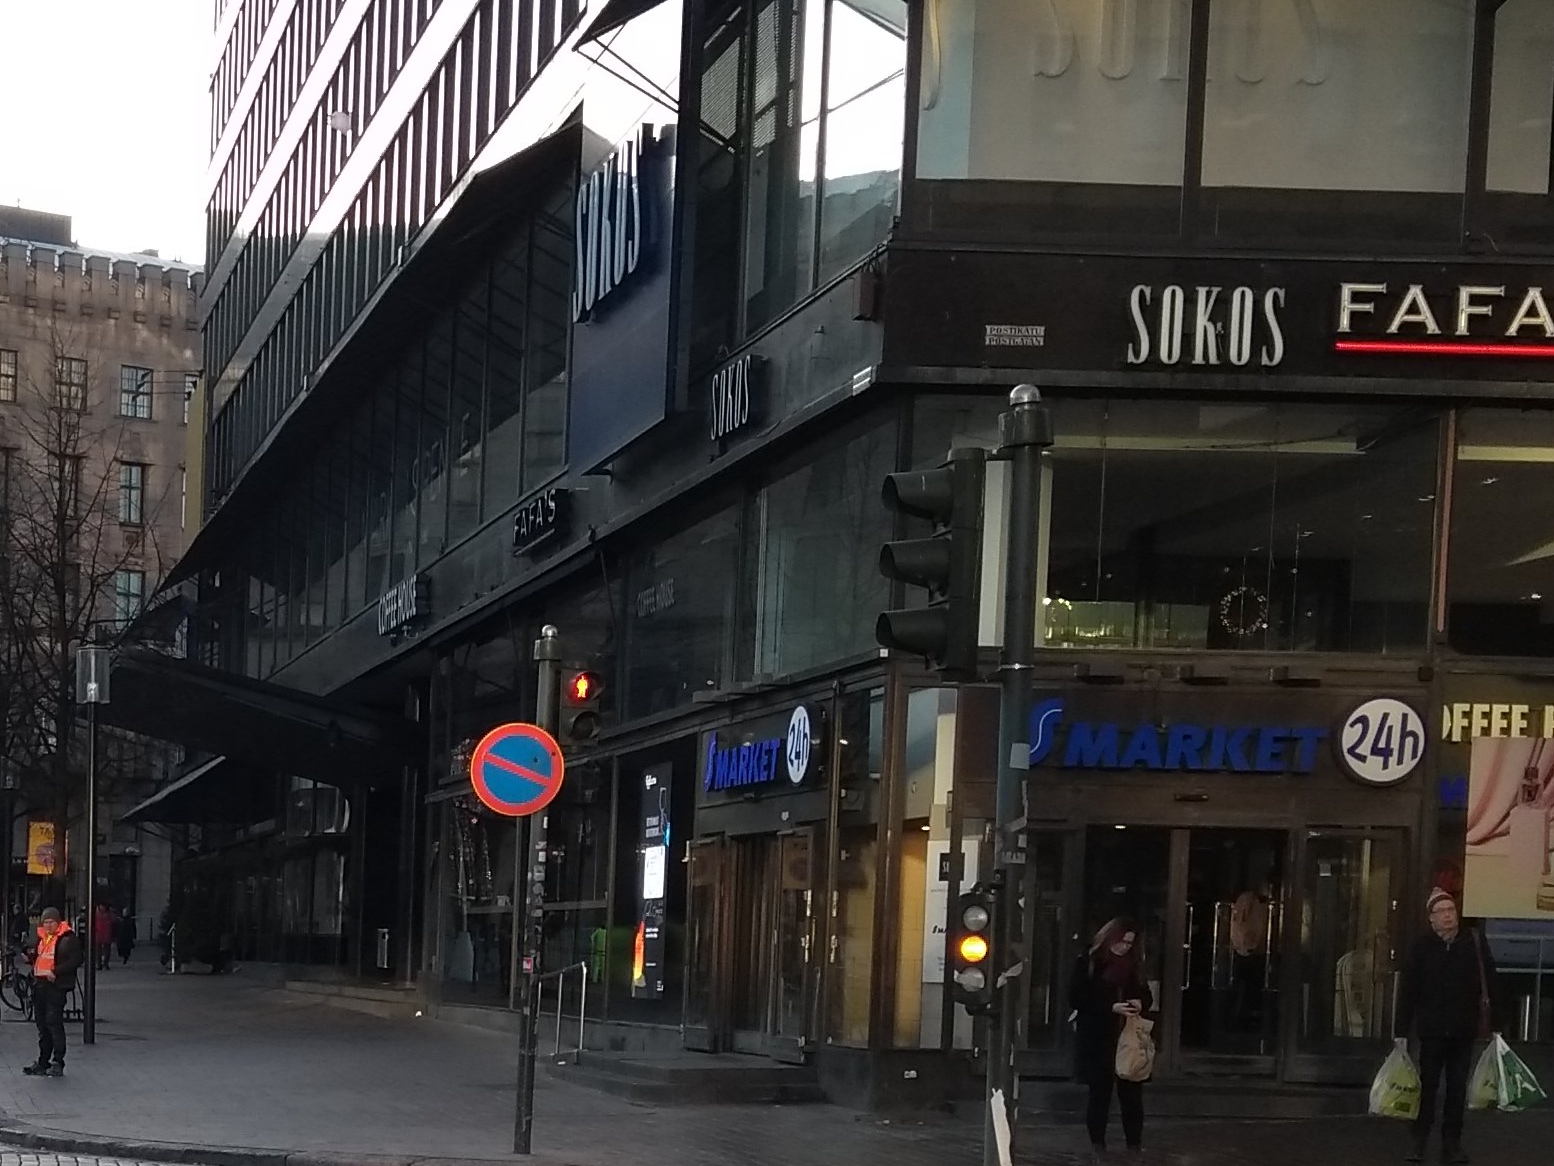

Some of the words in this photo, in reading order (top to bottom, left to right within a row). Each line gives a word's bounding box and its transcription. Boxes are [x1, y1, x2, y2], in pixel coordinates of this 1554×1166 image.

[572, 127, 641, 324] SOKOS
[1127, 284, 1286, 366] SOKOS
[710, 354, 751, 440] SOKOS
[513, 488, 556, 547] FAFA'S
[714, 738, 781, 790] MARKET
[789, 716, 808, 772] 24h
[1063, 723, 1331, 773] MARKET
[1346, 711, 1420, 771] 24h
